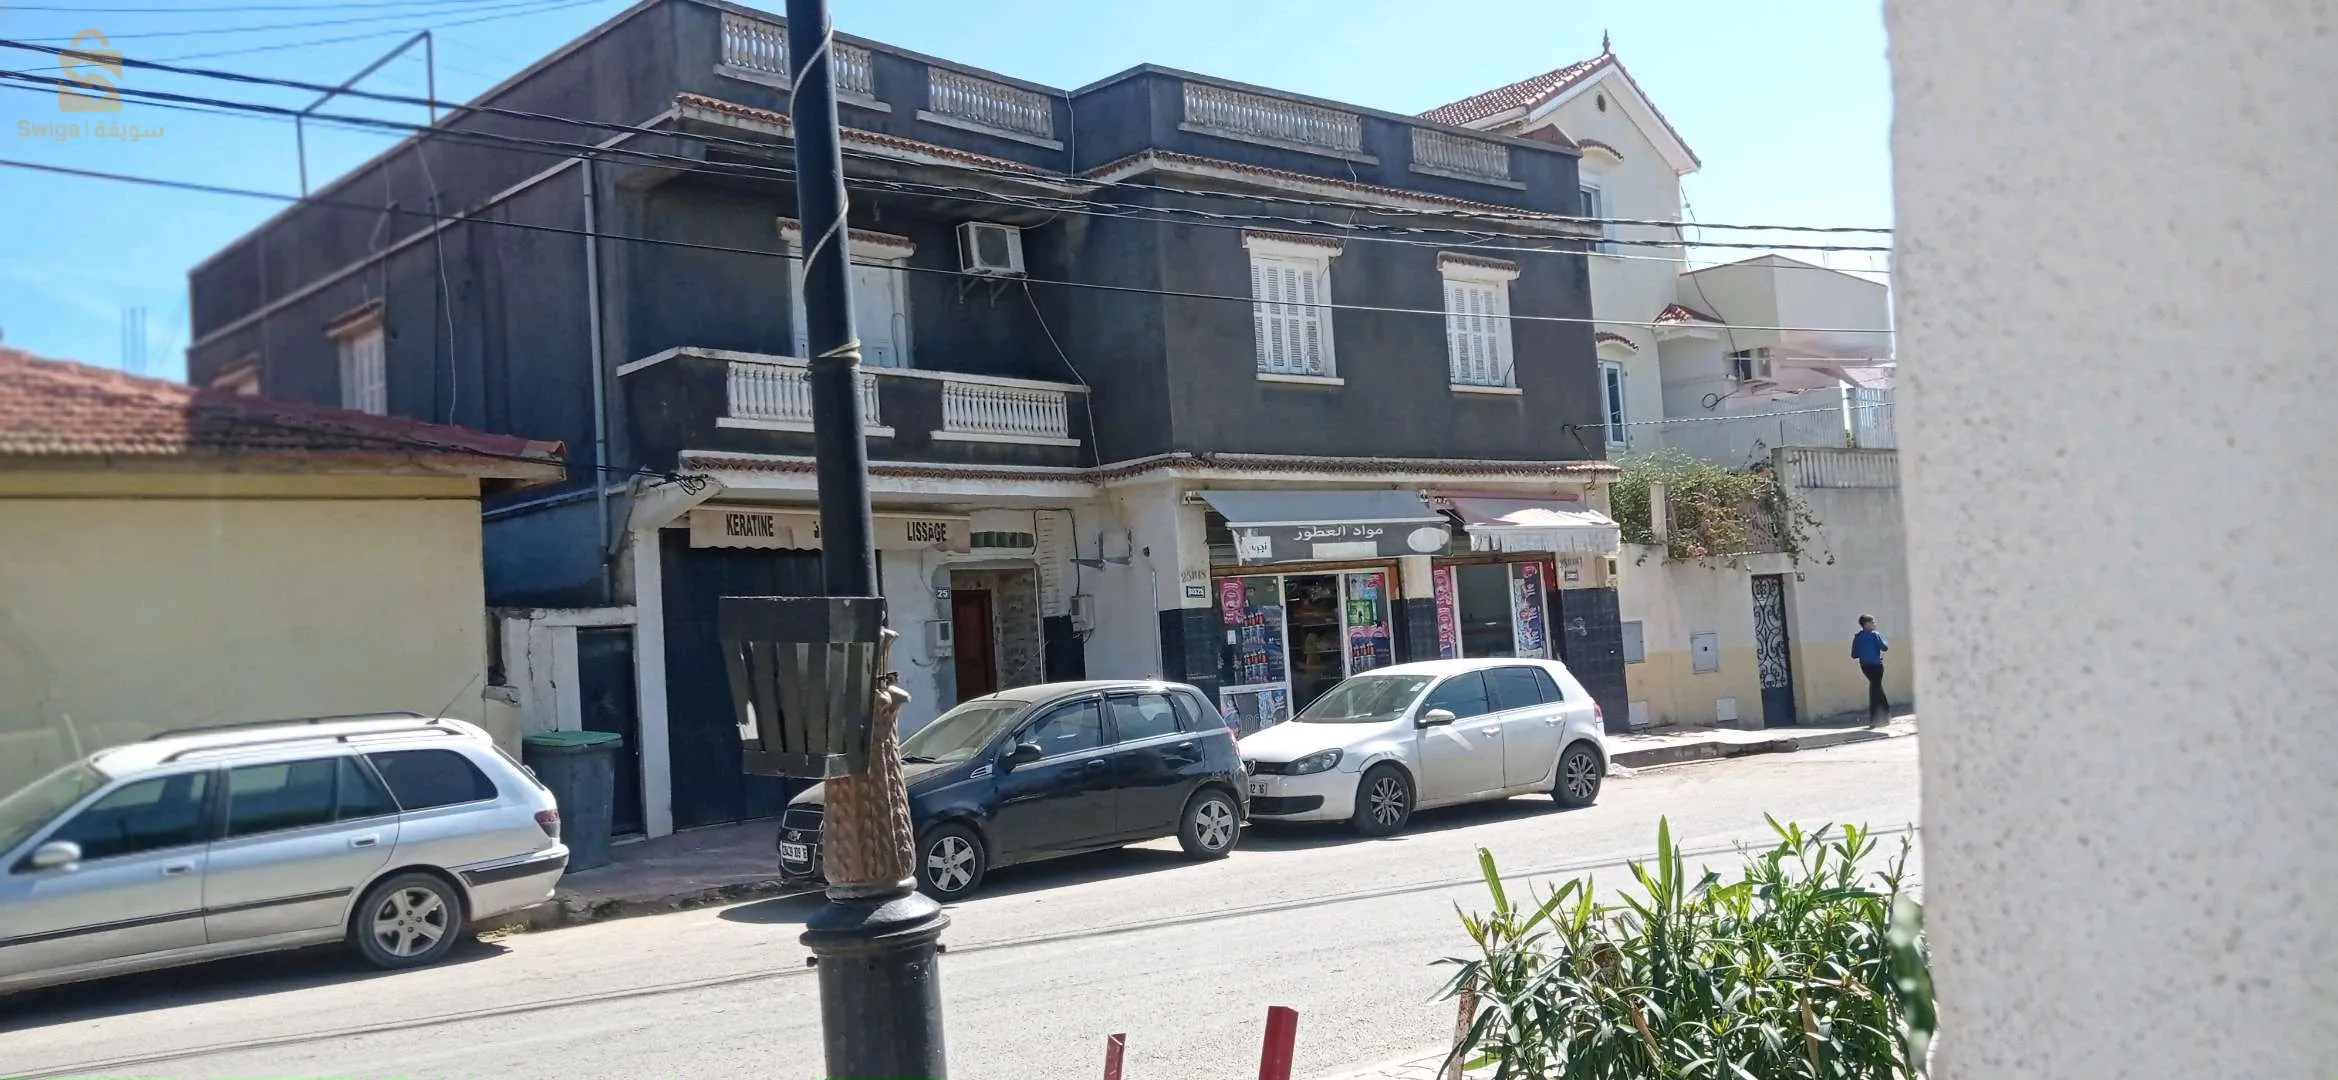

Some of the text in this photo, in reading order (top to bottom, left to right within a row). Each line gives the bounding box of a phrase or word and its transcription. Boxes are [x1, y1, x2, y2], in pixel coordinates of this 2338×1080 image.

[726, 513, 775, 537] KERATINE
[1294, 524, 1384, 541] مواد العطور
